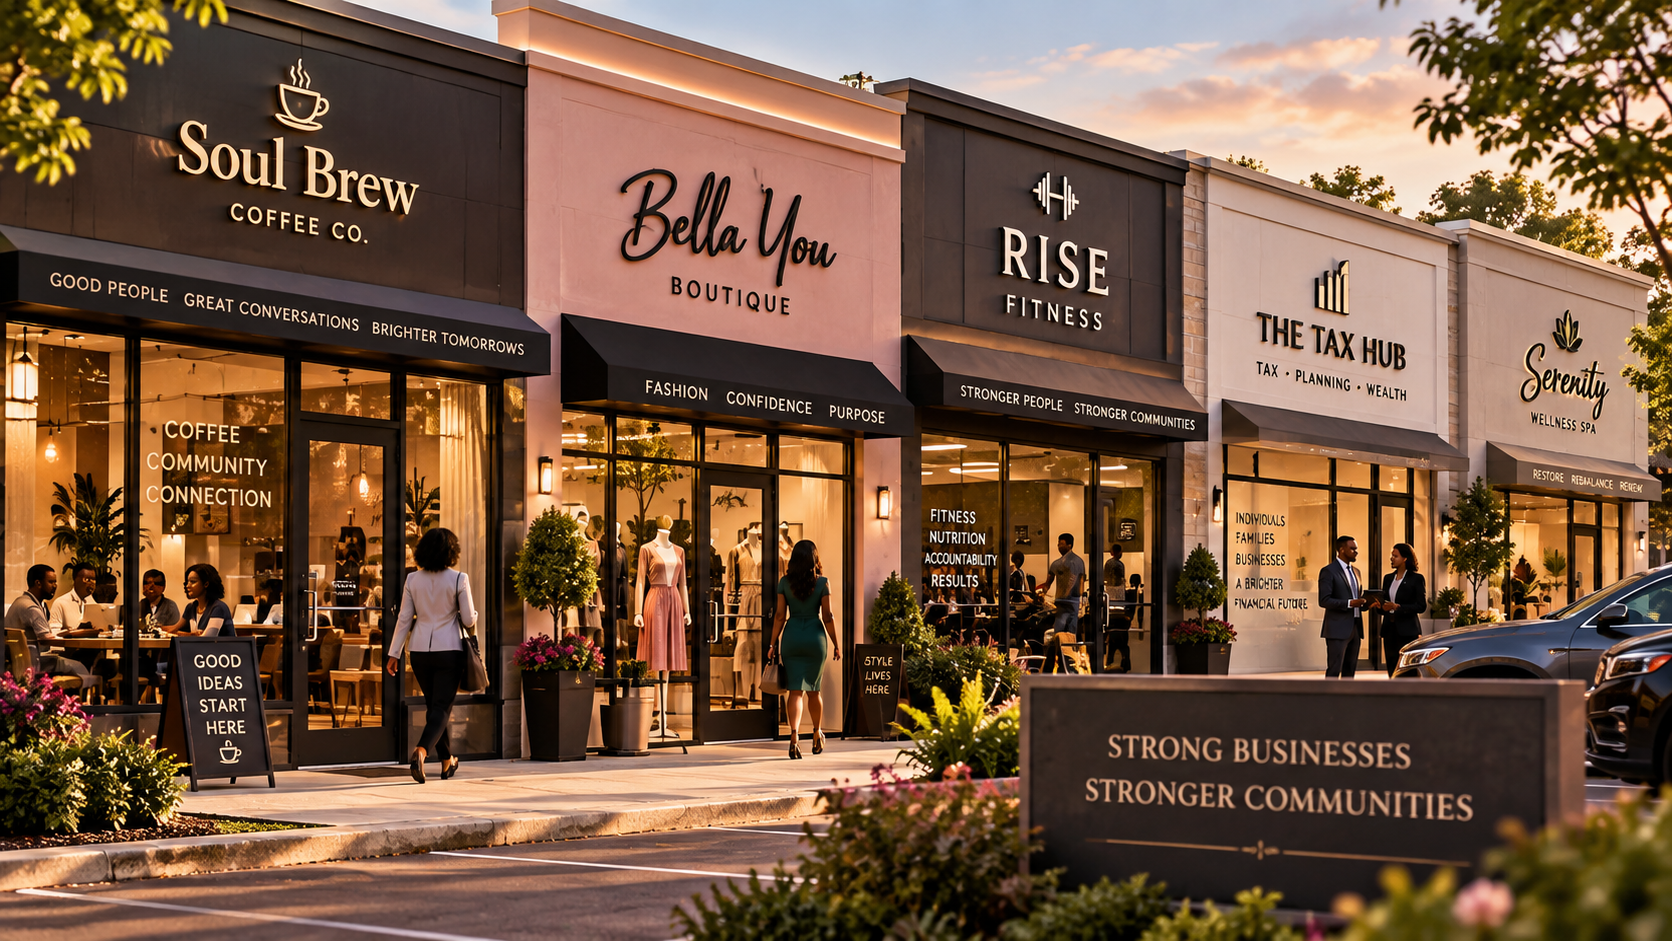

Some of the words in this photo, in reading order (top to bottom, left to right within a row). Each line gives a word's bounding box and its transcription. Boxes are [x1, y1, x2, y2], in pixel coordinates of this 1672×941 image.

[177, 119, 287, 191] Soul
[303, 145, 420, 215] Brew
[230, 202, 320, 236] COFFEE
[331, 222, 369, 244] CO.
[620, 168, 747, 262] Bella
[758, 184, 837, 287] You
[1001, 226, 1110, 296] RISE
[671, 276, 791, 316] BOUTIQUE
[50, 272, 102, 293] GOOD
[108, 281, 169, 304] PEOPLE
[184, 292, 235, 314] GREAT
[239, 301, 360, 332] CONVERSATIONS
[372, 321, 438, 344] BRIGHTER
[441, 330, 525, 356] TOMORROWS
[1006, 294, 1103, 331] FITNESS
[1256, 311, 1304, 350] THE
[1310, 323, 1355, 361] TAX
[1362, 335, 1407, 370] HUB
[1256, 361, 1279, 378] TAX
[1295, 370, 1351, 392] PLANNING
[1366, 383, 1407, 402] WEALTH
[1520, 342, 1610, 421] Serenity
[645, 379, 709, 401] FASHION
[726, 391, 813, 416] CONFIDENCE
[829, 405, 886, 425] PURPOSE
[960, 384, 1020, 406] STRONGER
[1023, 394, 1063, 412] PEOPLE
[1074, 402, 1127, 421] STRONGER
[1130, 410, 1196, 432] COMMUNITIES
[164, 420, 241, 444] COFFEE
[1530, 411, 1577, 432] WELLNESS
[1580, 421, 1597, 434] SPA
[146, 452, 268, 478] COMMUNITY
[1533, 469, 1565, 483] RESTORE
[145, 485, 272, 509] CONNECTION
[930, 508, 976, 525] FITNESS
[929, 530, 986, 546] NUTRITION
[1236, 531, 1275, 545] FAMILIES
[924, 552, 998, 567] ACCOUNTABILITY
[1236, 553, 1286, 566] BUSINESSES
[931, 574, 979, 588] RESULTS
[1235, 578, 1242, 589] A
[1245, 577, 1284, 590] BRIGHTER
[193, 653, 242, 669] GOOD
[864, 656, 893, 667] STYLE
[198, 675, 243, 691] IDEAS
[865, 671, 891, 681] LIVES
[865, 684, 890, 695] HERE
[199, 698, 247, 713] START
[206, 719, 246, 735] HERE
[1108, 733, 1223, 763] STRONG
[1233, 737, 1412, 770] BUSINESSES
[1085, 777, 1236, 809] STRONGER
[1244, 784, 1474, 822] COMMUNITIES
